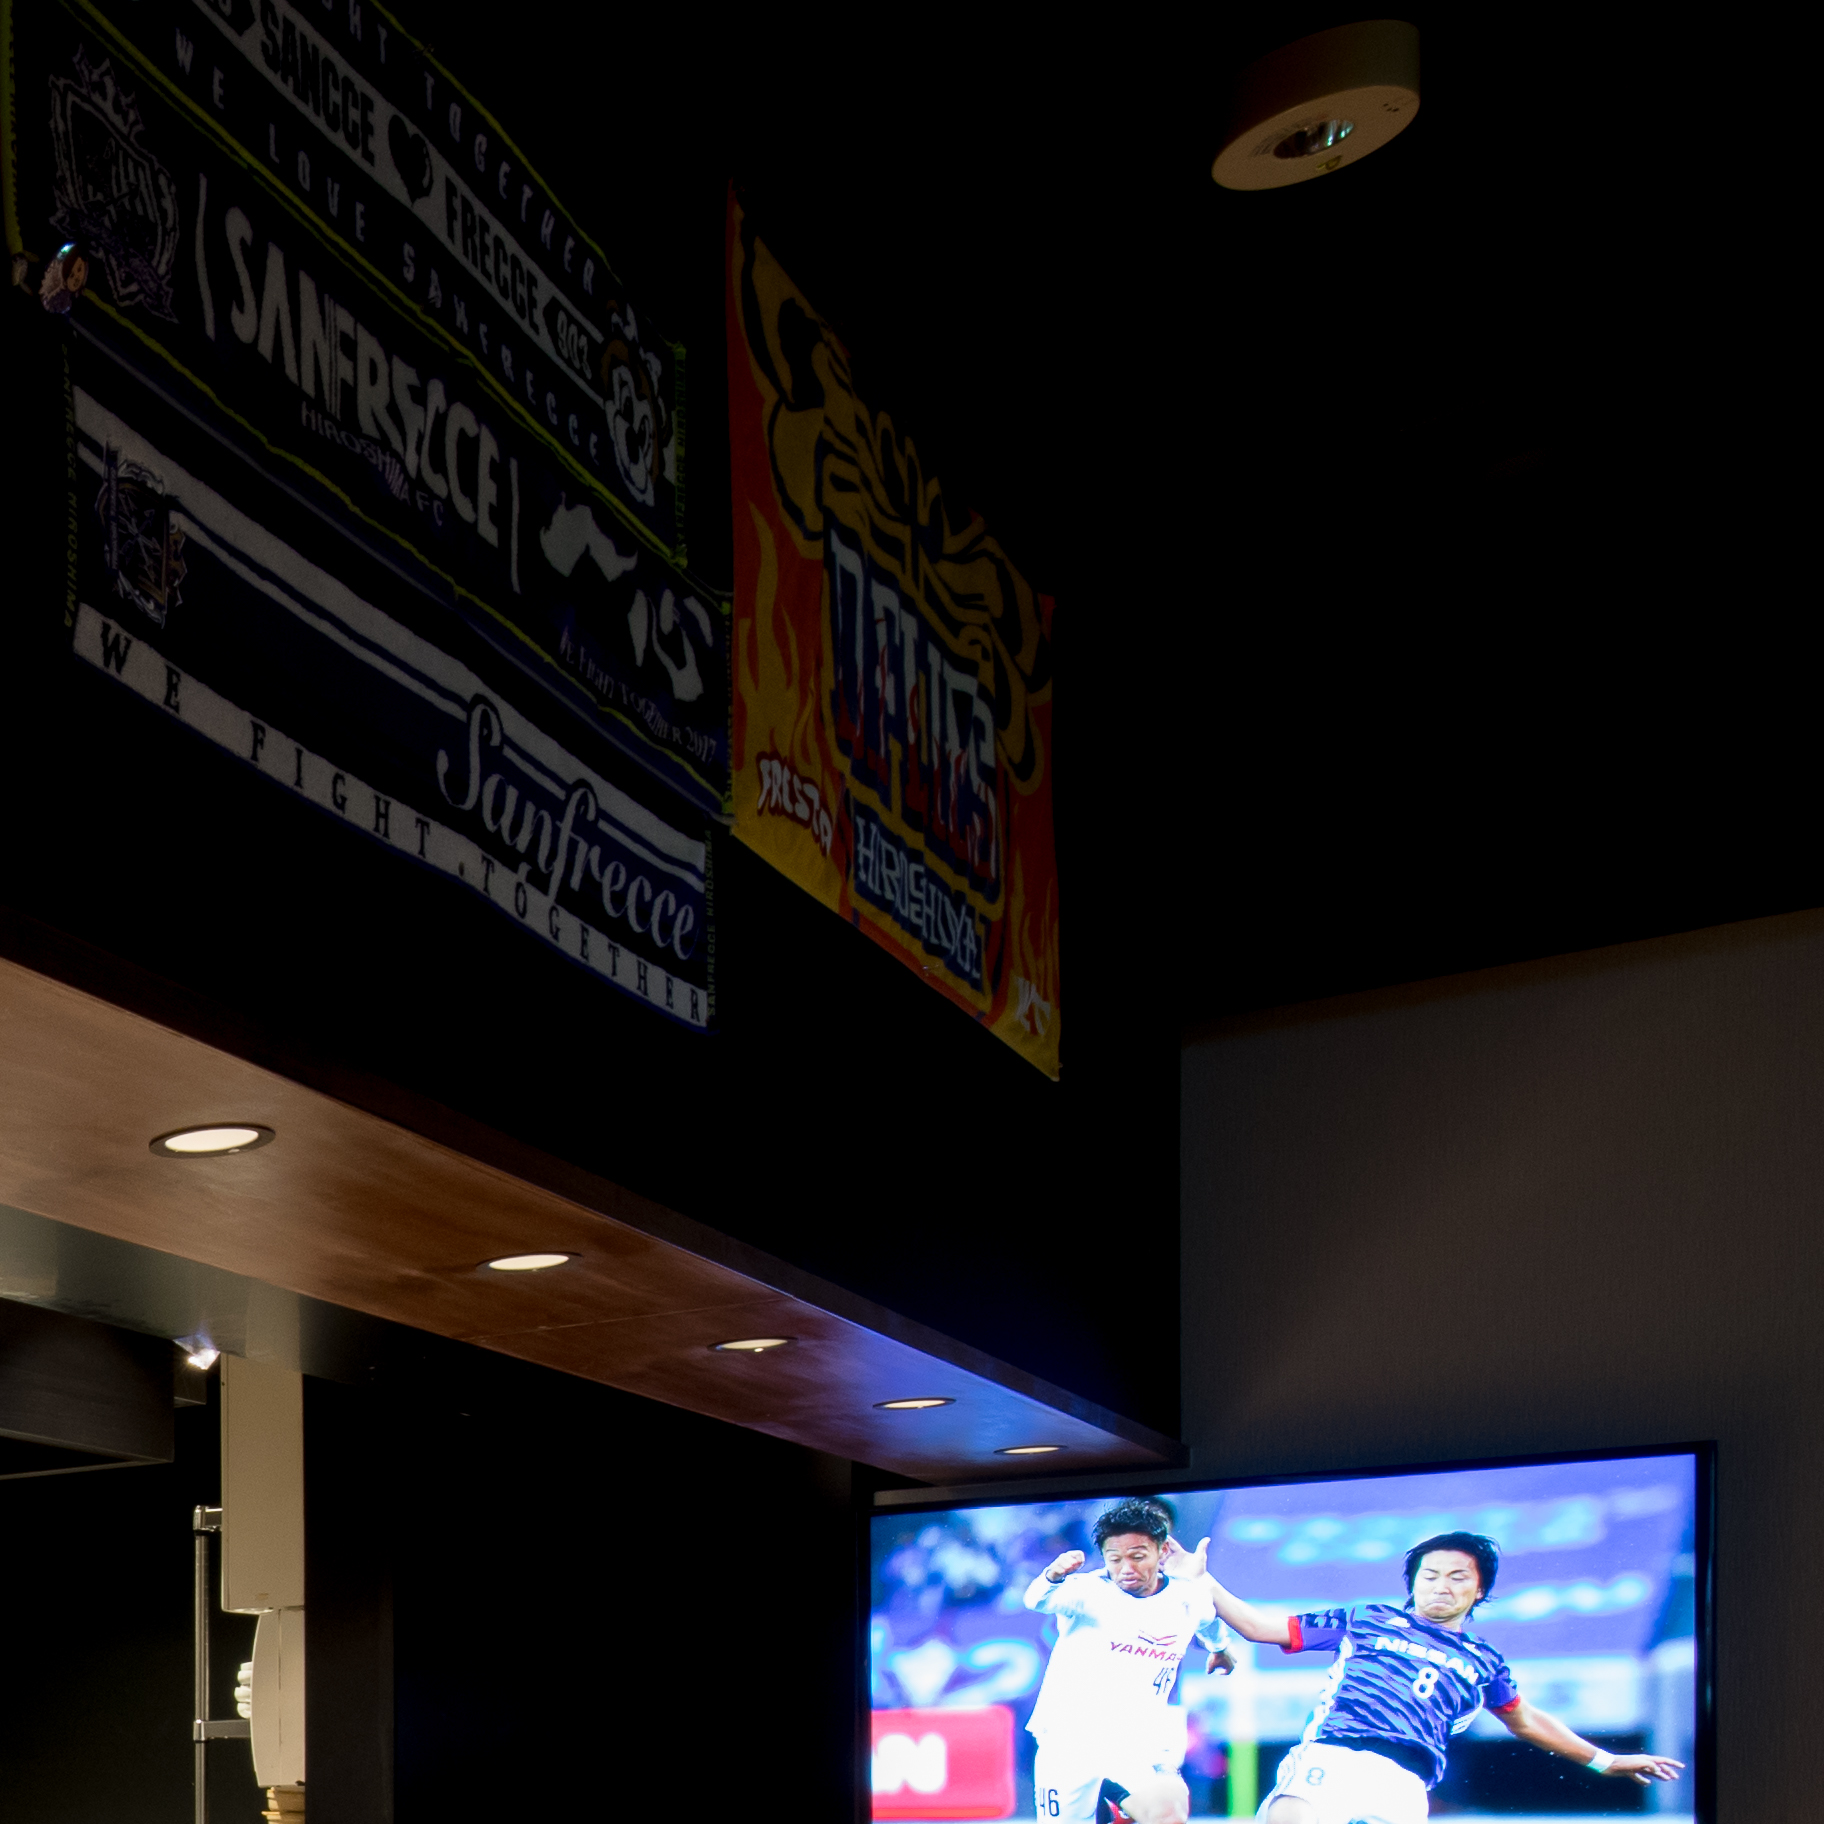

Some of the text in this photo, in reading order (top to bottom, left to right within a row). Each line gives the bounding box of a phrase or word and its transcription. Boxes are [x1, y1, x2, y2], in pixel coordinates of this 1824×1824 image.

[174, 26, 600, 467] WE LOVE SANFRECCE
[424, 70, 595, 296] TOGETHER
[446, 175, 544, 337] FRECCE
[224, 205, 501, 550] SANFRECCE
[301, 400, 445, 527] HIROSHIMA FC
[62, 491, 79, 629] HIROSHIMA
[101, 621, 702, 1024] WE FIGHT TOGETHER
[435, 702, 700, 961] Sanfrecce
[855, 814, 983, 980] HIROSHIMA
[1374, 1636, 1480, 1686] NISSAN
[1412, 1666, 1440, 1700] 8
[1305, 1766, 1326, 1787] 8
